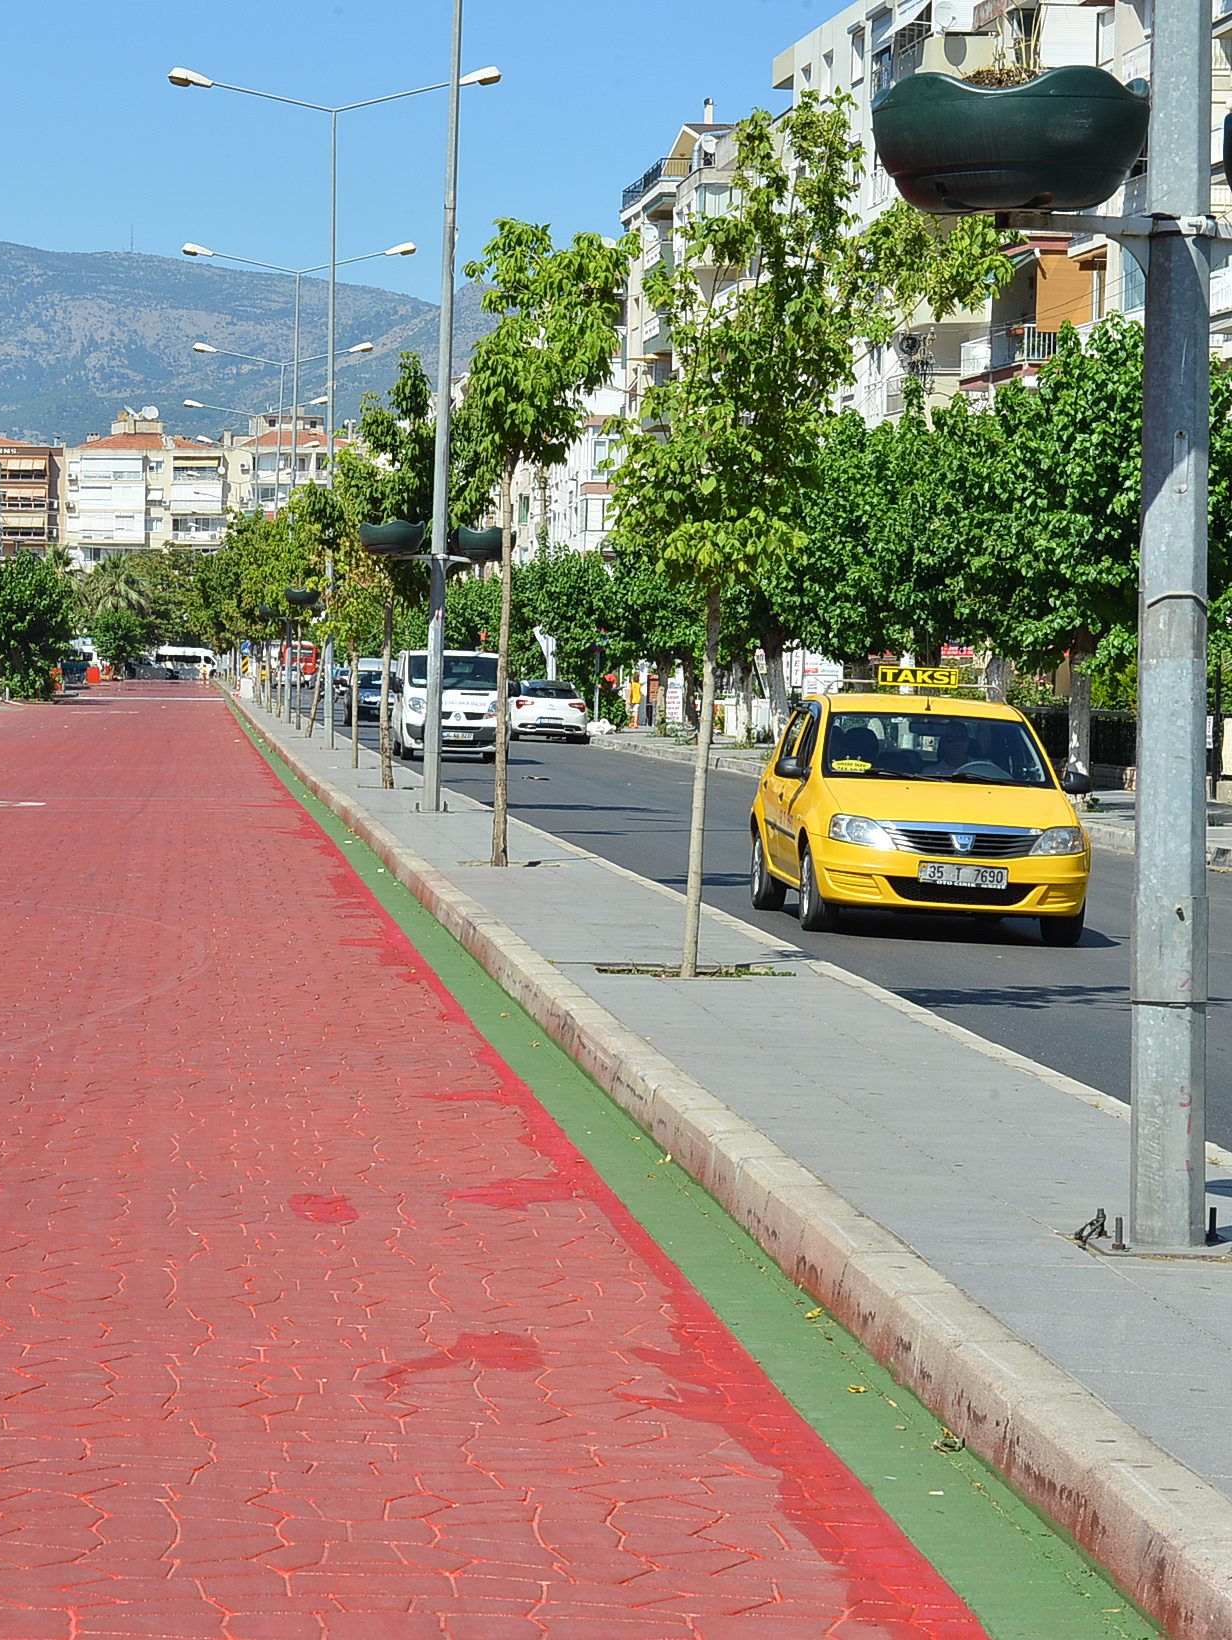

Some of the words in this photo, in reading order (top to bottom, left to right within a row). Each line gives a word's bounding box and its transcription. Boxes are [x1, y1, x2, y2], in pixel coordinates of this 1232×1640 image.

[928, 865, 944, 879] 35
[956, 867, 962, 881] T
[974, 869, 1004, 884] 7690
